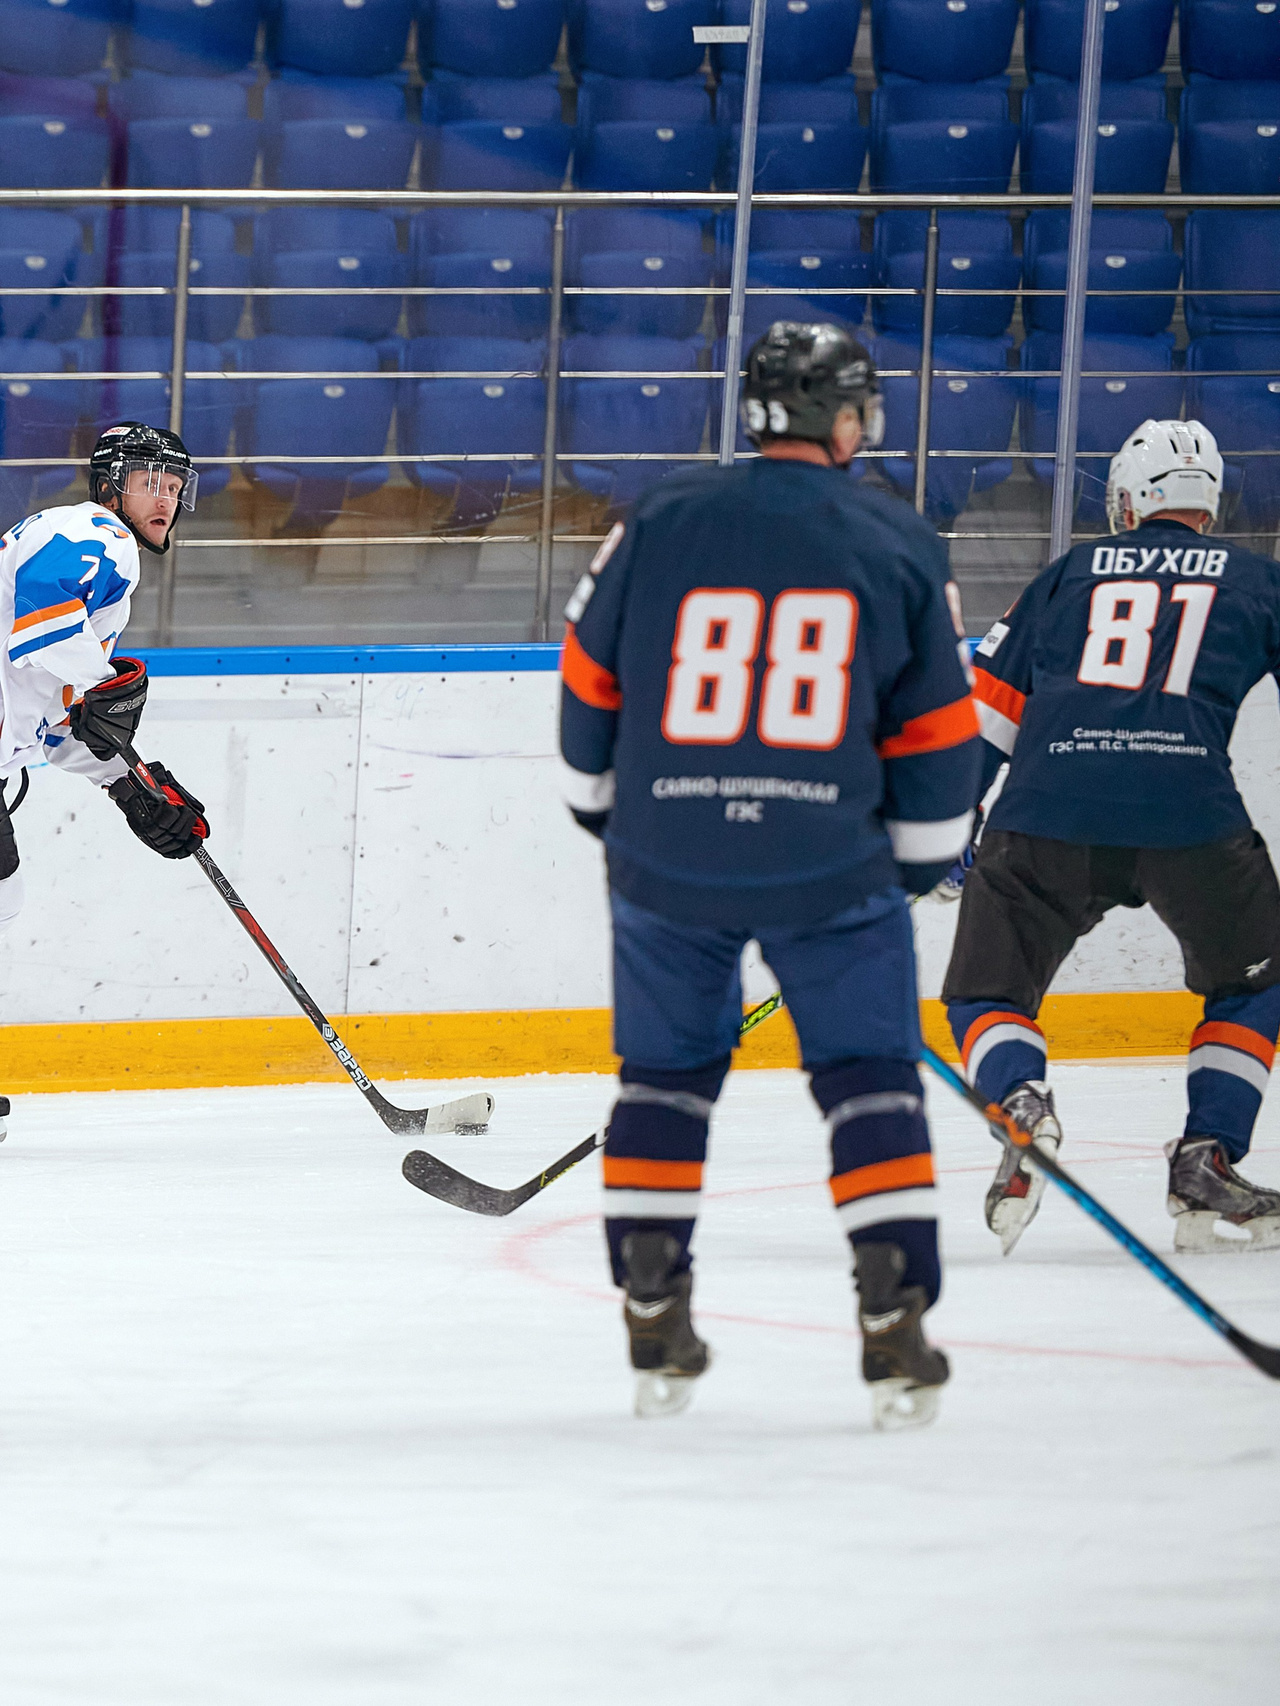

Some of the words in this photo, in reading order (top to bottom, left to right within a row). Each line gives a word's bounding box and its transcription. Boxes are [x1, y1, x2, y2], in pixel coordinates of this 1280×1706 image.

[163, 448, 187, 459] BAUER
[1091, 546, 1229, 577] ОБУХОВ
[1076, 579, 1218, 697] 81
[660, 586, 860, 752] 88
[1048, 740, 1075, 754] ГЭС
[725, 800, 763, 823] ГЭС
